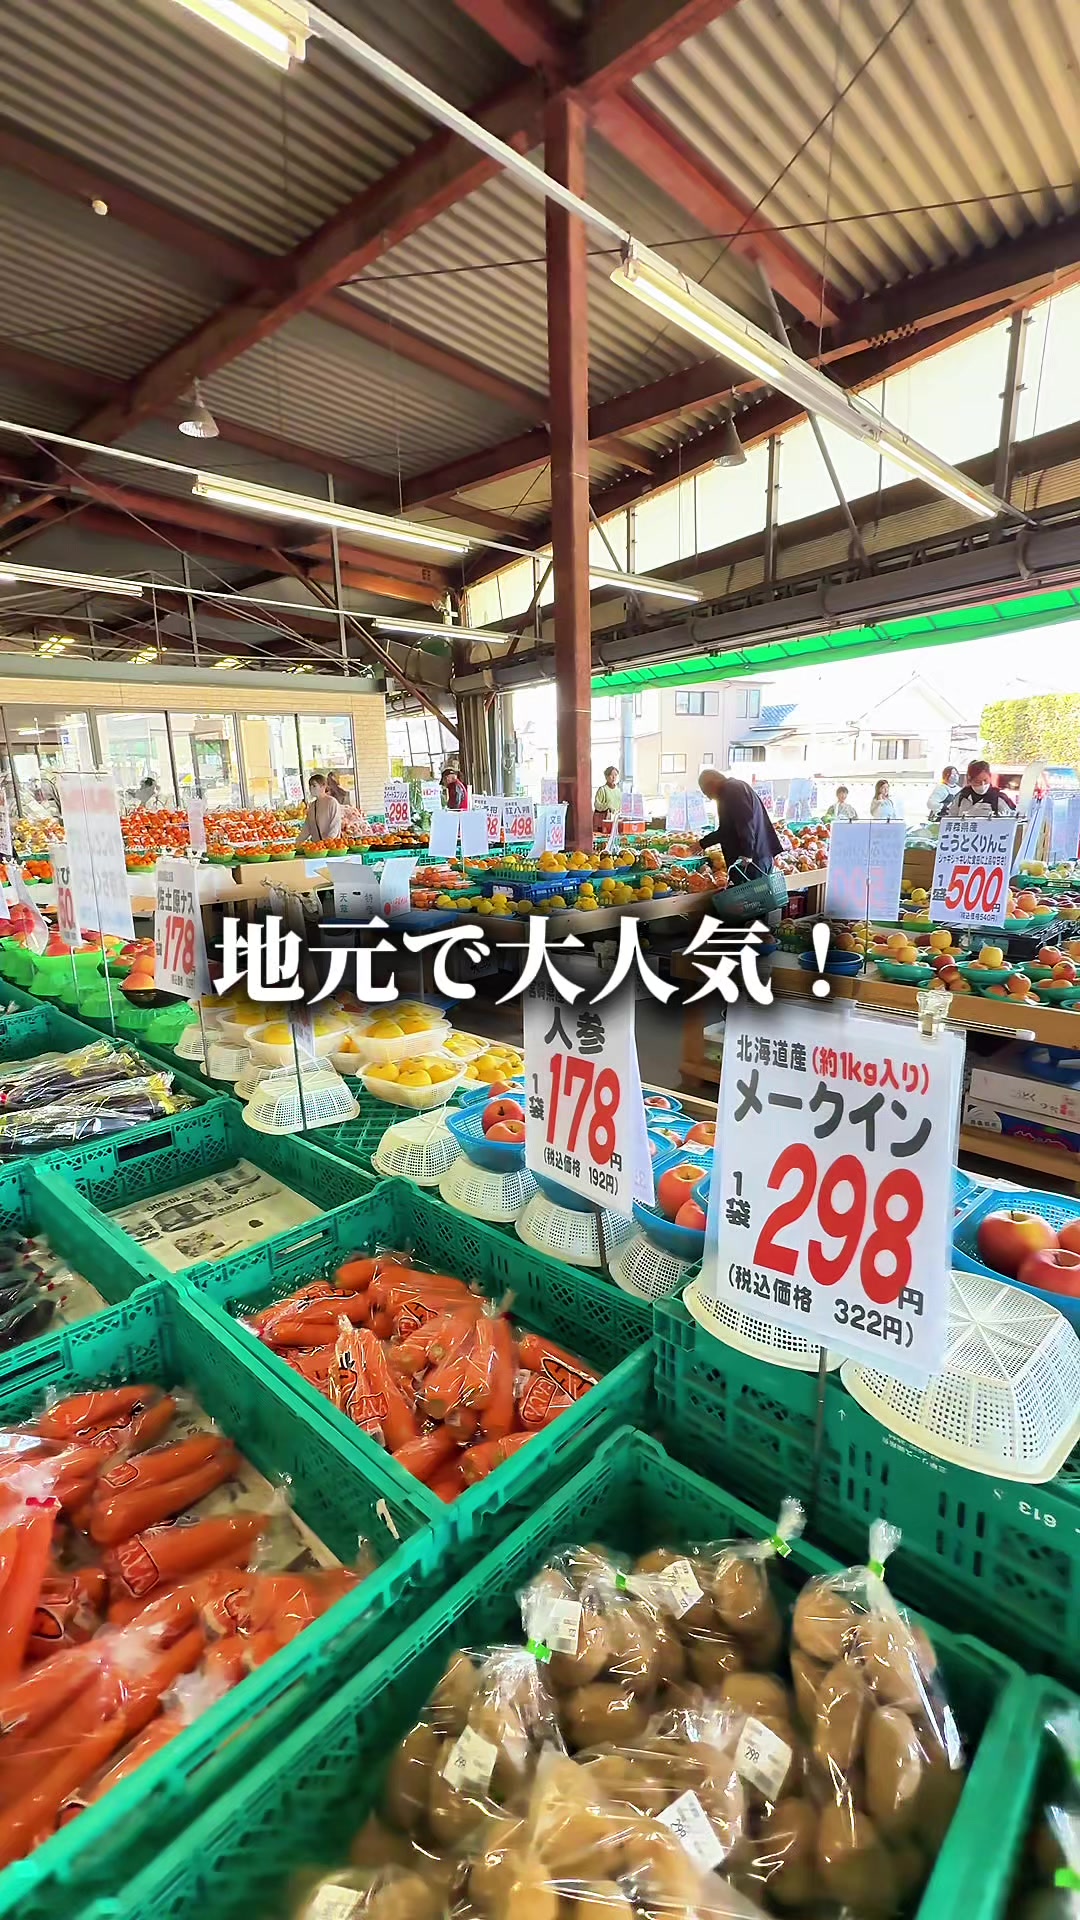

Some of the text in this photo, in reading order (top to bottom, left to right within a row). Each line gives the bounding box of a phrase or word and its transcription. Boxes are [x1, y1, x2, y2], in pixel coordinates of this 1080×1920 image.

[390, 802, 408, 821] 298
[510, 816, 532, 837] 498
[940, 833, 1009, 853] こうとくりんご
[544, 1006, 605, 1054] 人参
[736, 1034, 807, 1073] 北海道産
[734, 1068, 932, 1158] メークイン
[1018, 1500, 1057, 1528] 613
